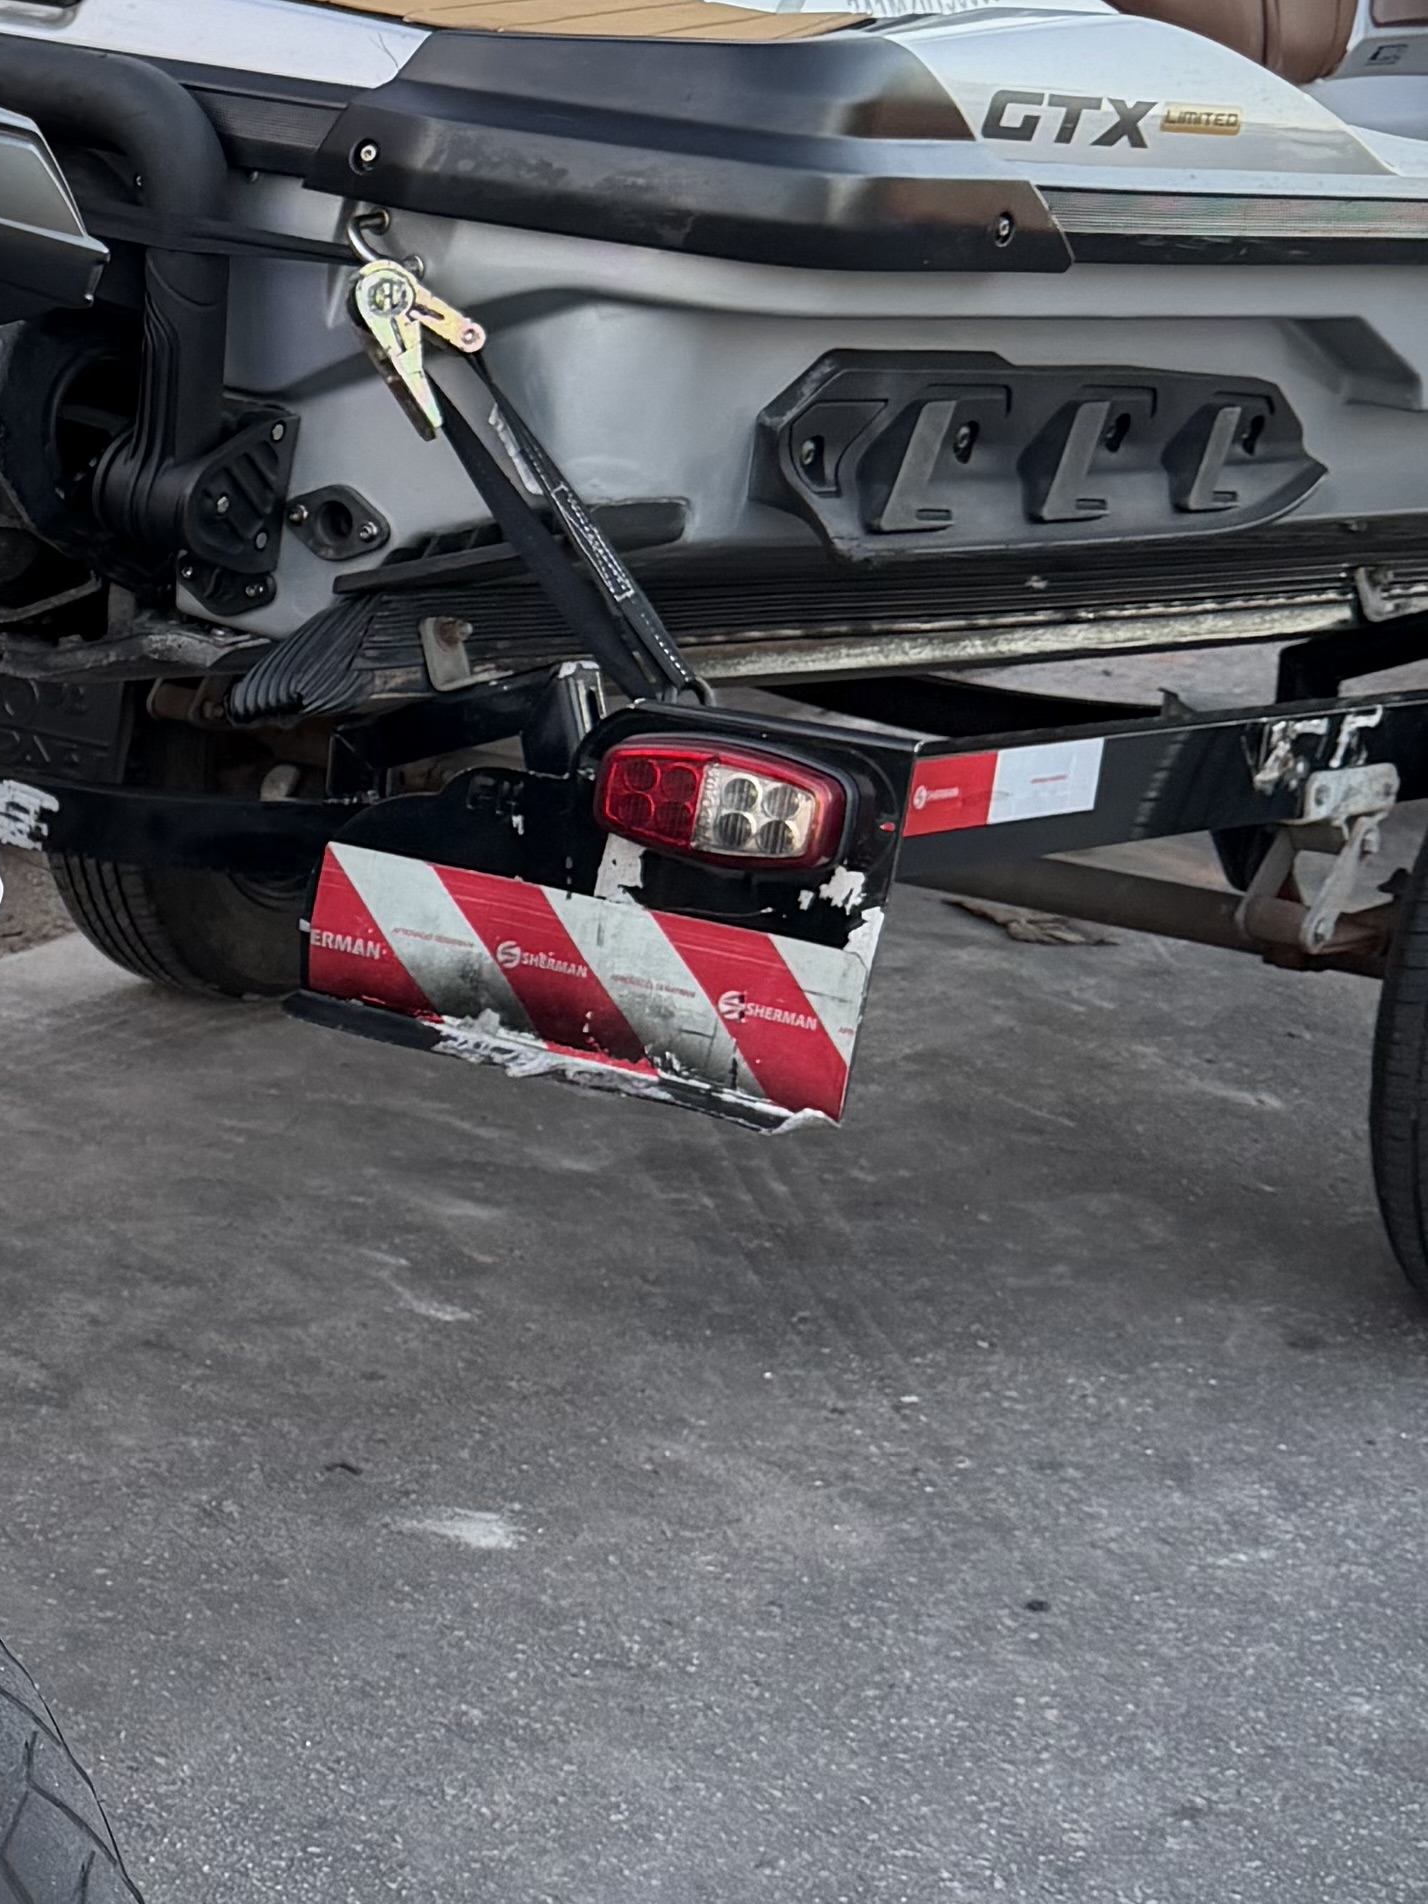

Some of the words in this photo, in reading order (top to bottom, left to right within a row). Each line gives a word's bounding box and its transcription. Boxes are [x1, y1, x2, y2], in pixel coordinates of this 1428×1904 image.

[981, 89, 1158, 149] GTX
[1164, 108, 1239, 127] LIMITED
[309, 928, 380, 960] ERMAN
[520, 950, 588, 978] SHERMAN
[745, 1001, 817, 1031] SHERMAN
